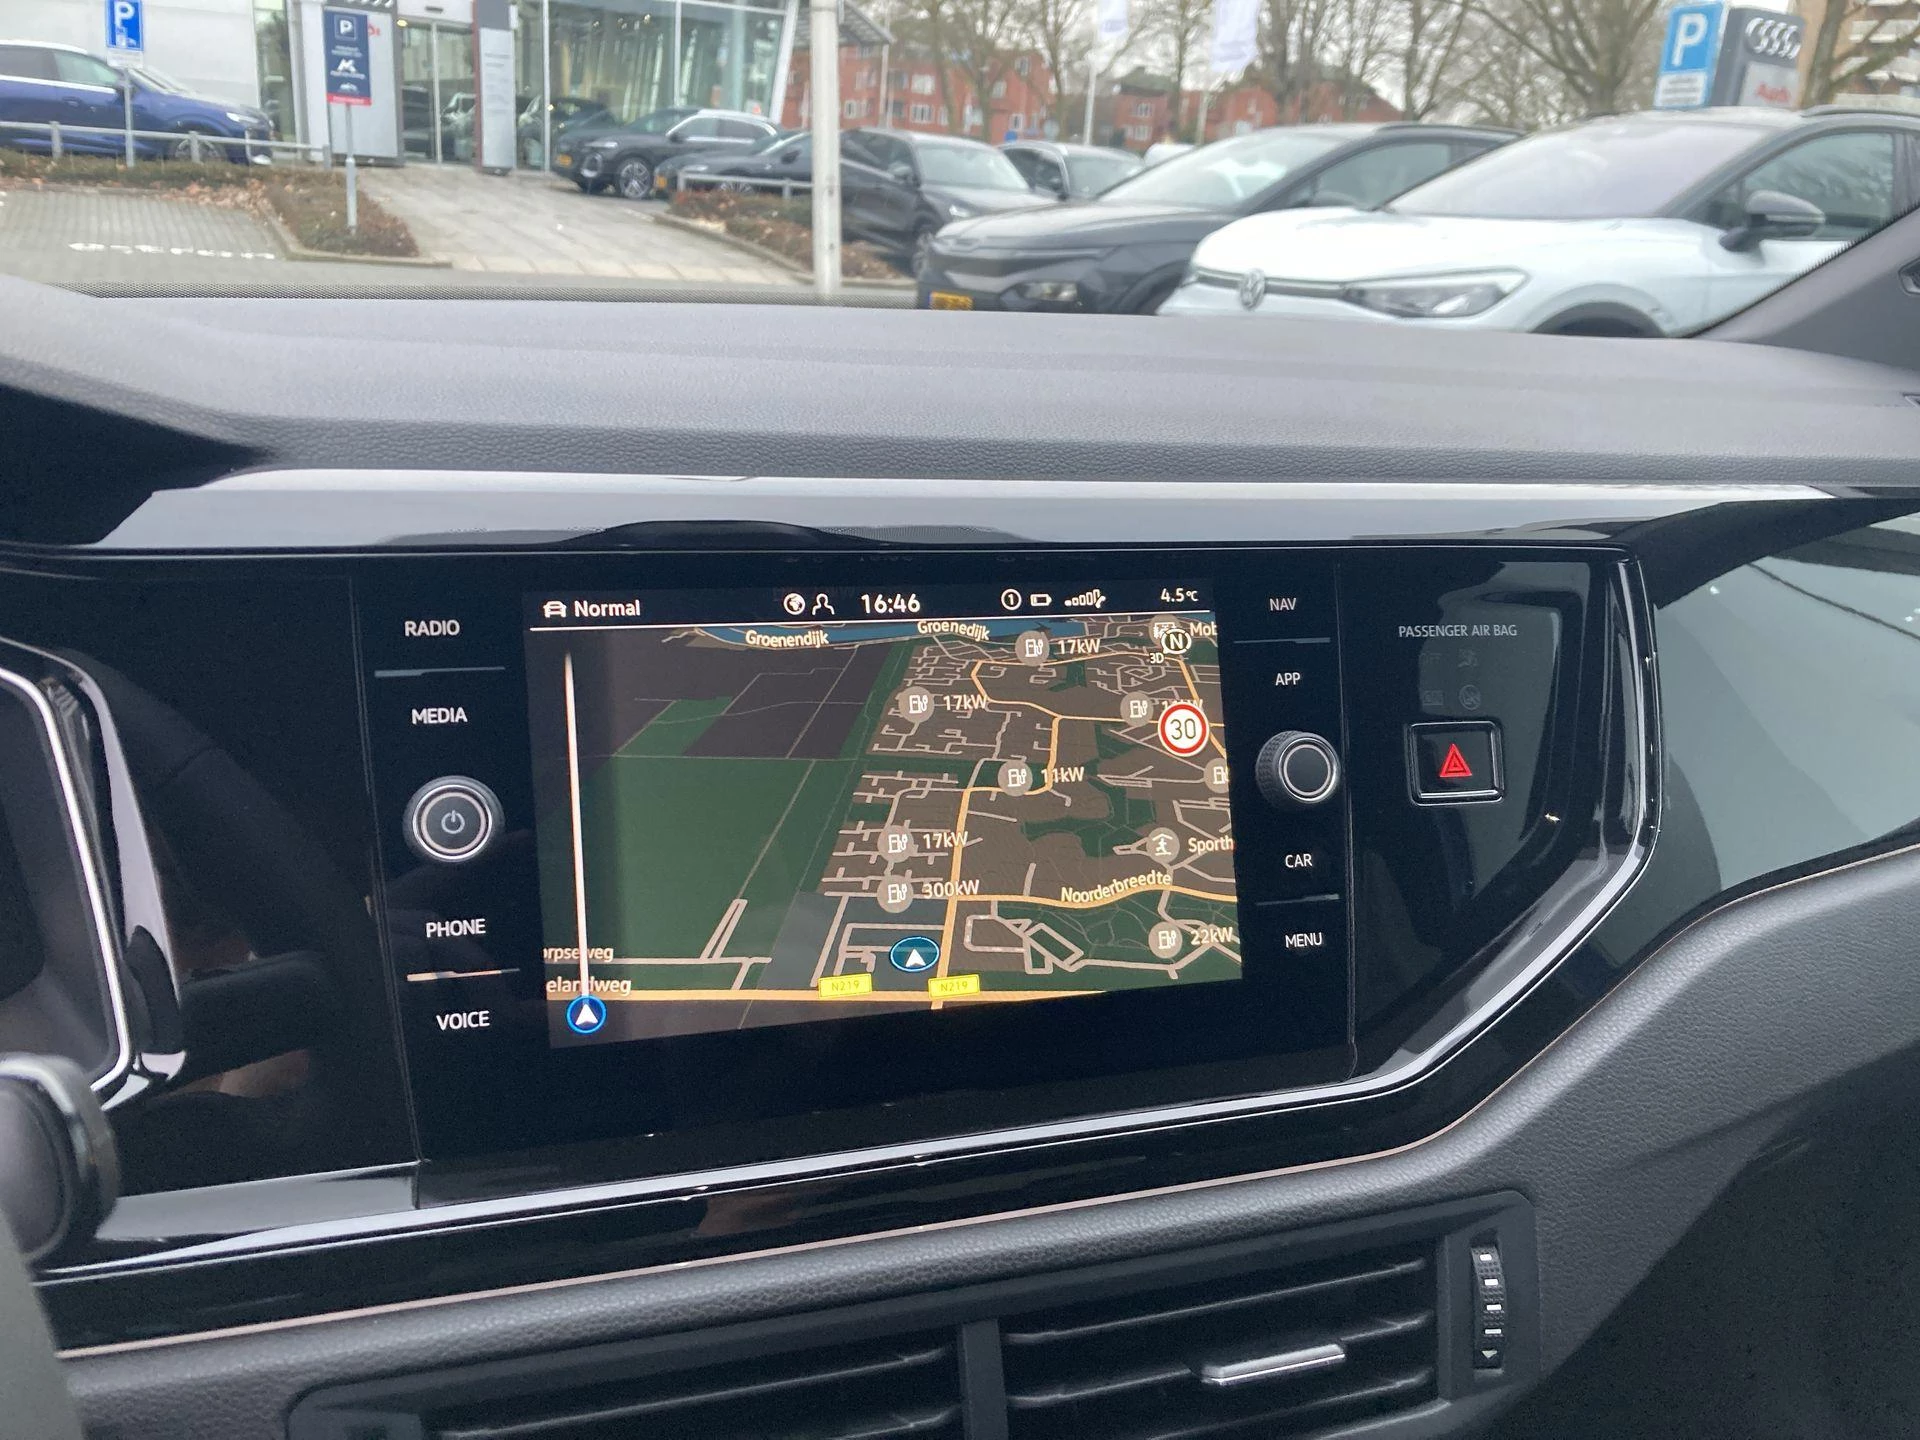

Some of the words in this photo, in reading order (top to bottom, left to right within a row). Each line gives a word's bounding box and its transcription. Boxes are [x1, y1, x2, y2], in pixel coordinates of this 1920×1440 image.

[114, 1, 136, 28] P
[1672, 13, 1708, 66] P
[574, 599, 641, 617] Normal
[861, 593, 921, 613] 16:46
[1269, 597, 1297, 611] NAV
[404, 619, 460, 637] RADIO
[917, 620, 990, 641] Groenedijk
[1398, 625, 1468, 638] PASSENGER
[1471, 624, 1491, 637] AIR
[1494, 624, 1517, 637] BAG
[745, 629, 828, 648] Groenendijk
[1057, 637, 1101, 655] 17kW
[1169, 633, 1184, 650] N
[1149, 652, 1165, 664] 3D
[1275, 672, 1301, 686] APP
[943, 694, 988, 710] 17kW
[411, 707, 468, 725] MEDIA
[1169, 717, 1196, 741] 30
[922, 831, 969, 849] 17kW
[1285, 853, 1313, 868] CAR
[922, 879, 980, 899] 300kW
[1060, 869, 1172, 903] Noorderbreedte
[425, 918, 486, 938] PHONE
[1190, 926, 1234, 946] 22kW
[1285, 932, 1323, 948] MENU
[435, 1010, 491, 1031] VOICE
